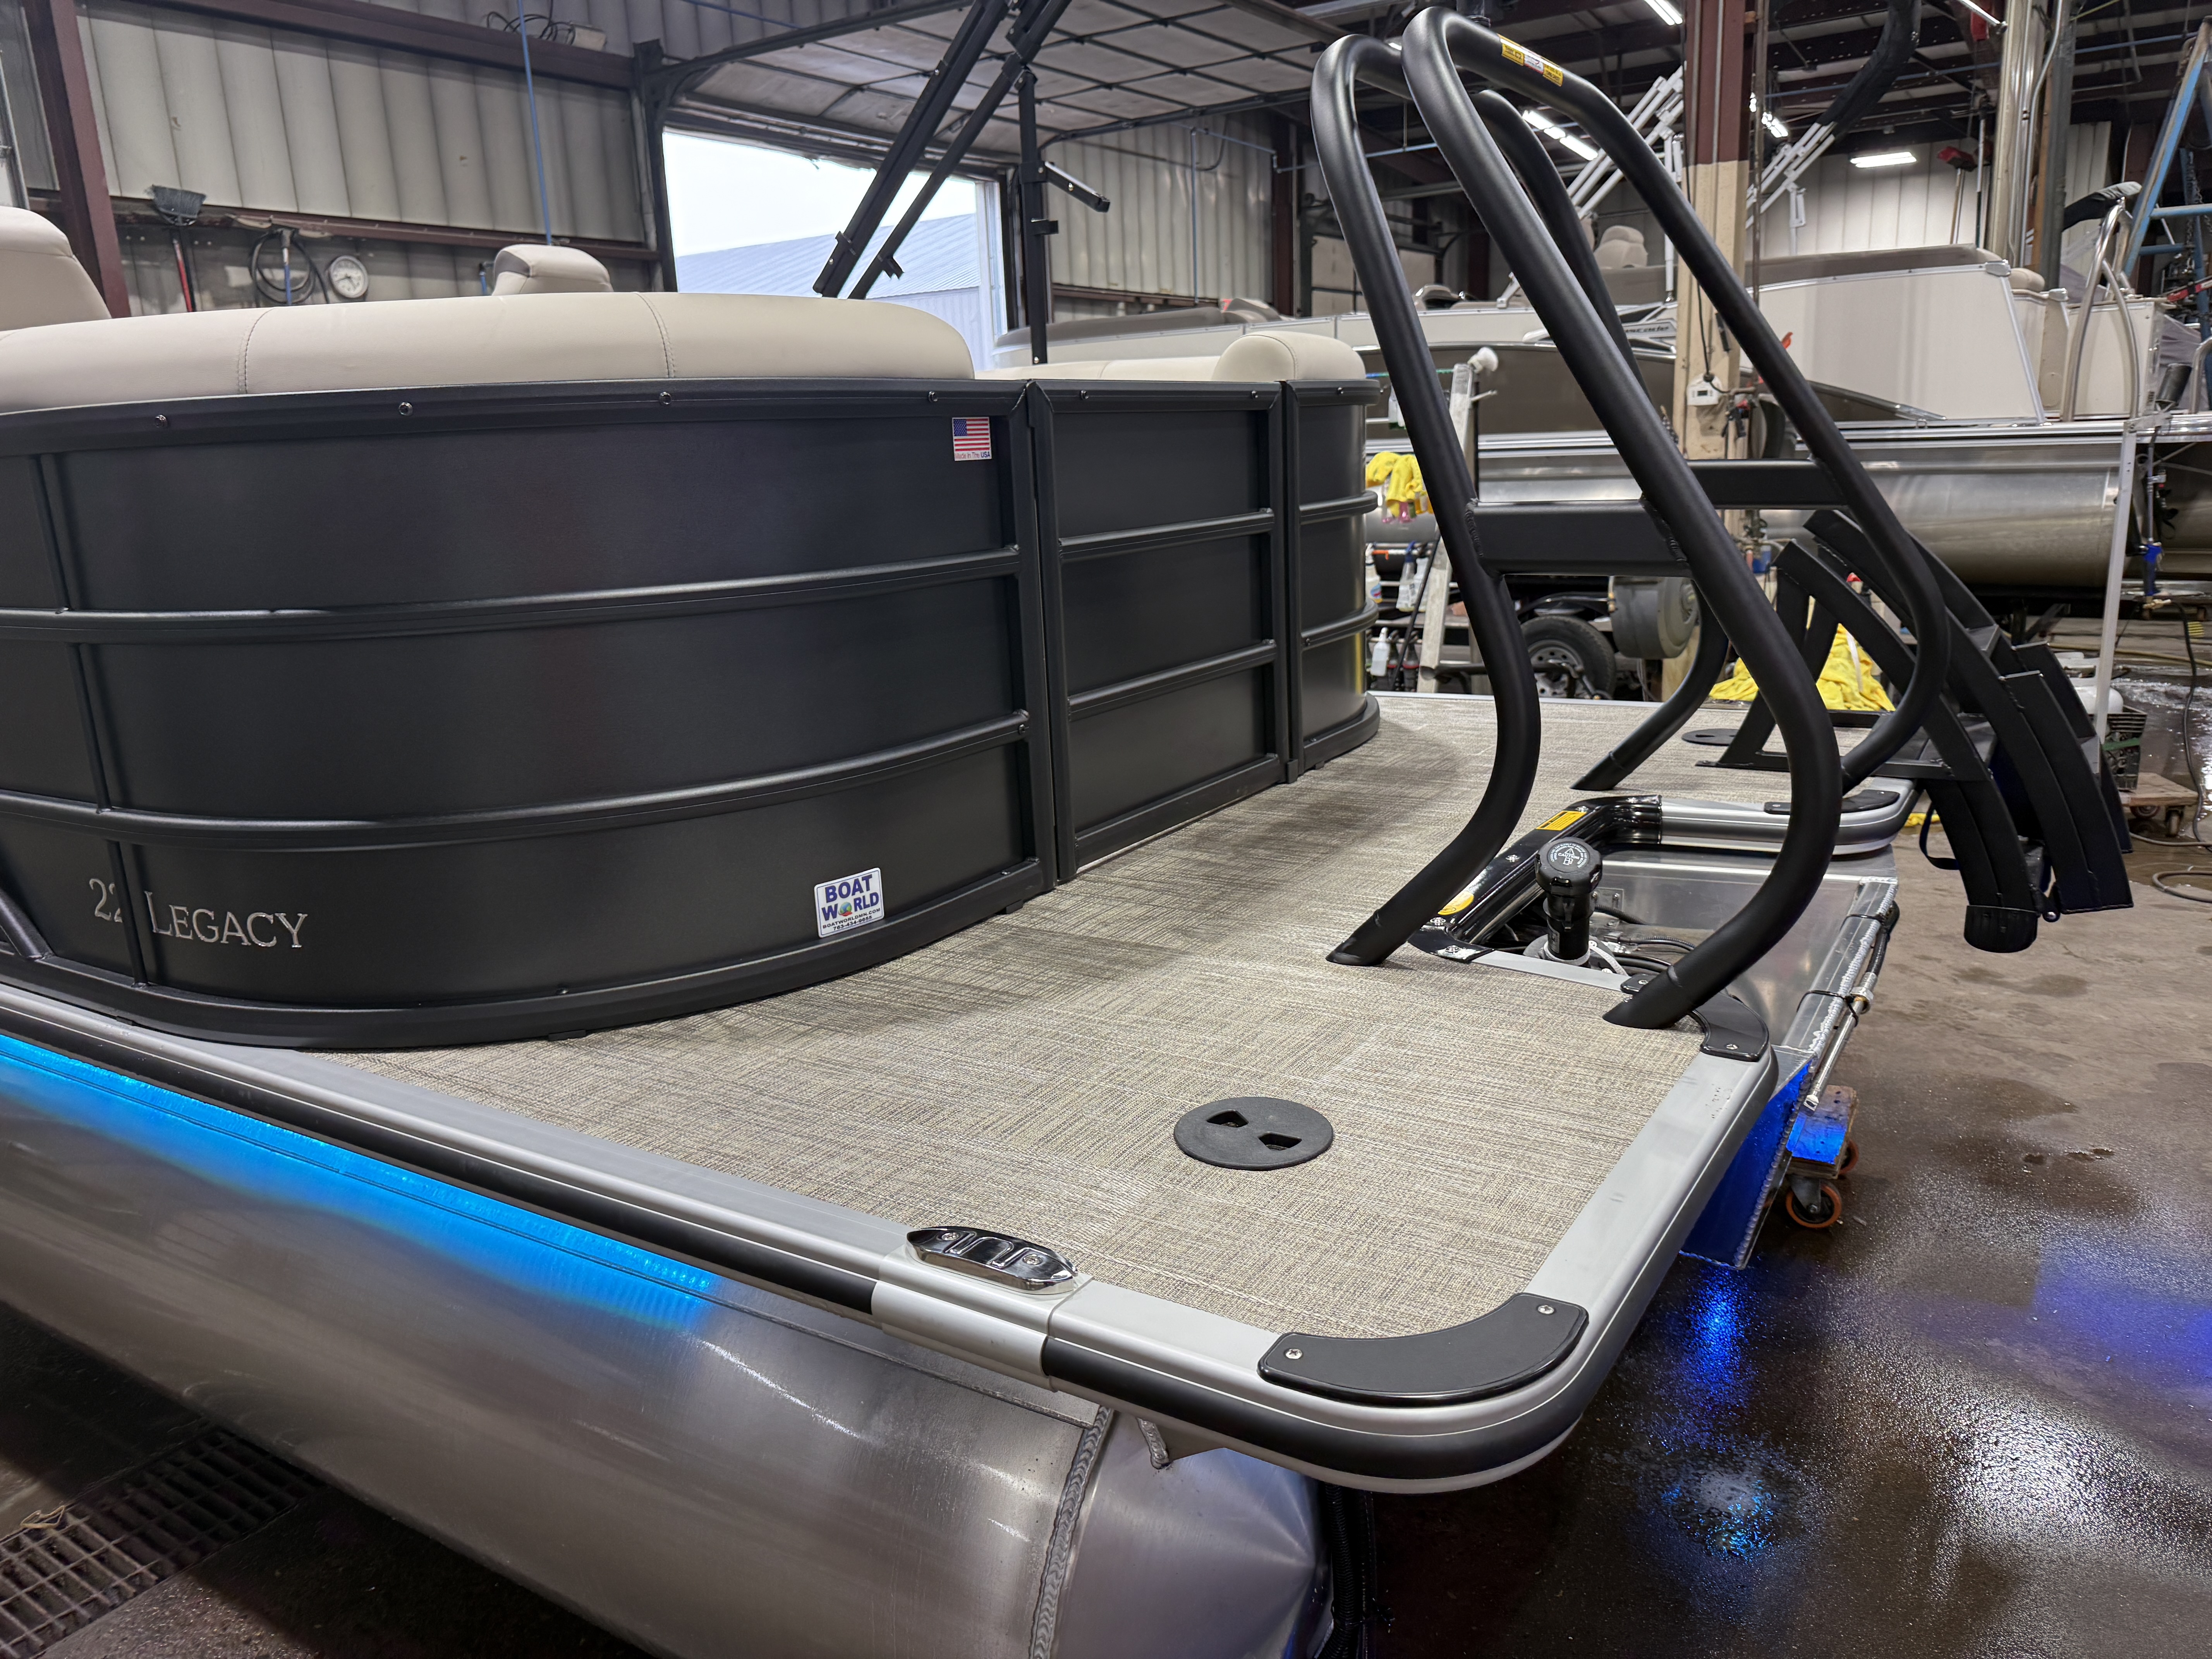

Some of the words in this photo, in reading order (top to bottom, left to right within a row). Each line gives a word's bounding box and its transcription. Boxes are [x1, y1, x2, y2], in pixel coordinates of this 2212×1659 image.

[825, 874, 872, 903] BOAT
[144, 891, 308, 948] LEGACY
[823, 908, 881, 929] BOATWORLDMN.COM
